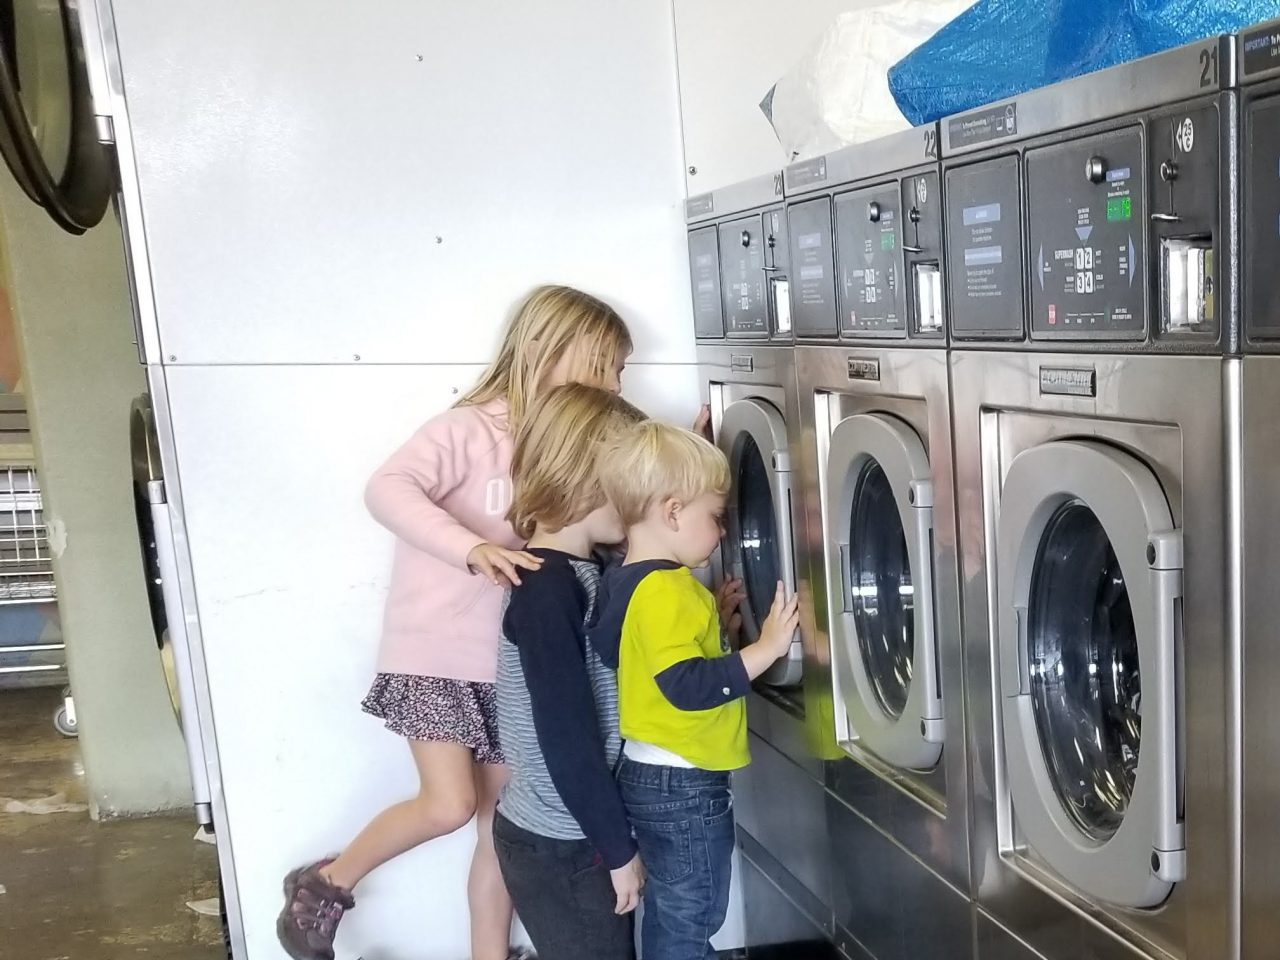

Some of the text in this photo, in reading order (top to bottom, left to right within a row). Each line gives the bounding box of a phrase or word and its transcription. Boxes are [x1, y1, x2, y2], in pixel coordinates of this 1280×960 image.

[1271, 35, 1276, 45] To
[1200, 45, 1217, 88] 21
[923, 130, 936, 158] 22
